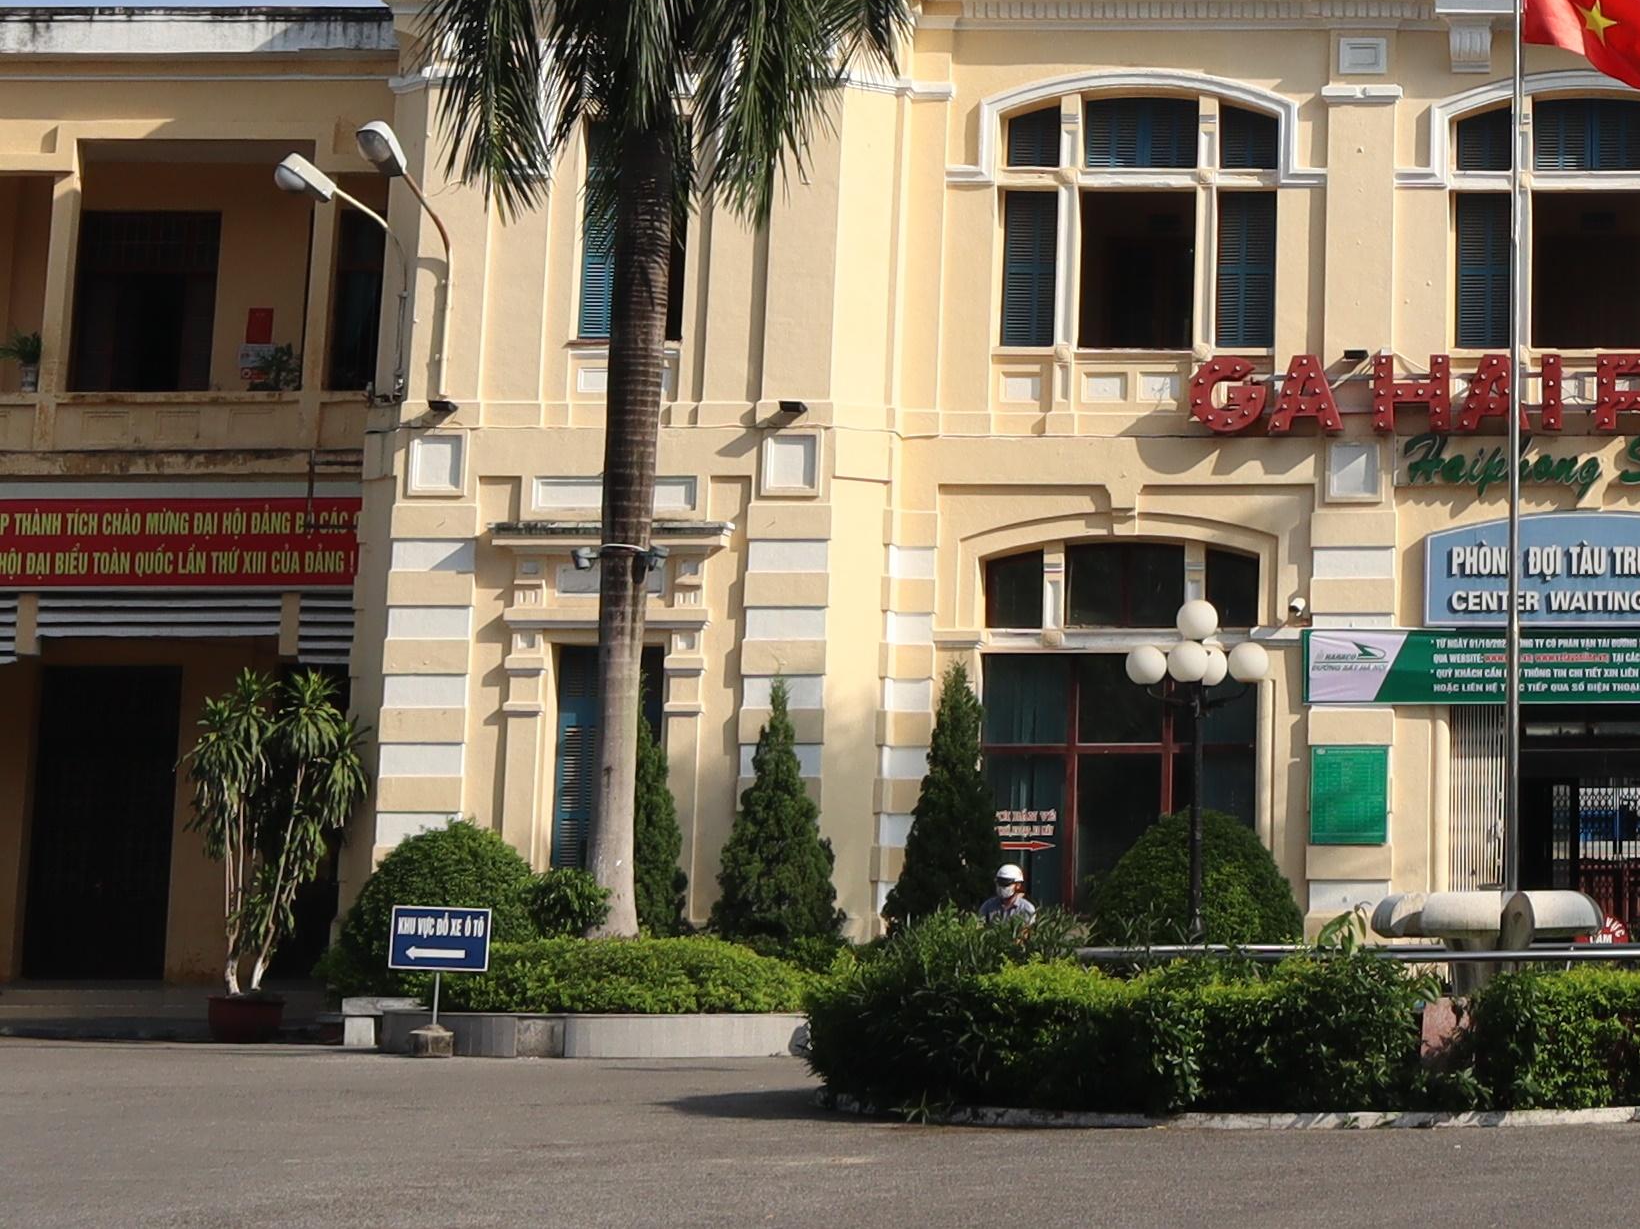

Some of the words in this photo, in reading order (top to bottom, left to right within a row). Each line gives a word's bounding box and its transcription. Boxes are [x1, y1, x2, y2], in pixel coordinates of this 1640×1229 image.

[1190, 354, 1344, 432] GA
[1373, 354, 1563, 431] HAI
[1404, 433, 1603, 499] Haiphong
[14, 508, 62, 536] THÀNH
[66, 508, 98, 536] TÍCH
[103, 508, 141, 536] CHÀO
[145, 508, 189, 535] MỪNG
[193, 512, 218, 540] ĐẠI
[222, 508, 246, 540] HỘI
[251, 504, 291, 535] ĐẢNG
[25, 552, 50, 580] ĐẠI
[55, 543, 88, 575] BIỂU
[93, 546, 130, 575] TOÀN
[135, 543, 174, 577] QUỐC
[211, 546, 240, 574] THỨ
[242, 551, 267, 574] XIII
[272, 543, 300, 574] CỦA
[304, 543, 345, 574] ĐẢNG
[1528, 544, 1562, 580] ĐỢI
[1569, 539, 1606, 575] TÀU
[1469, 638, 1507, 648] 01/10/202
[397, 917, 416, 935] KHU
[449, 918, 462, 936] XE
